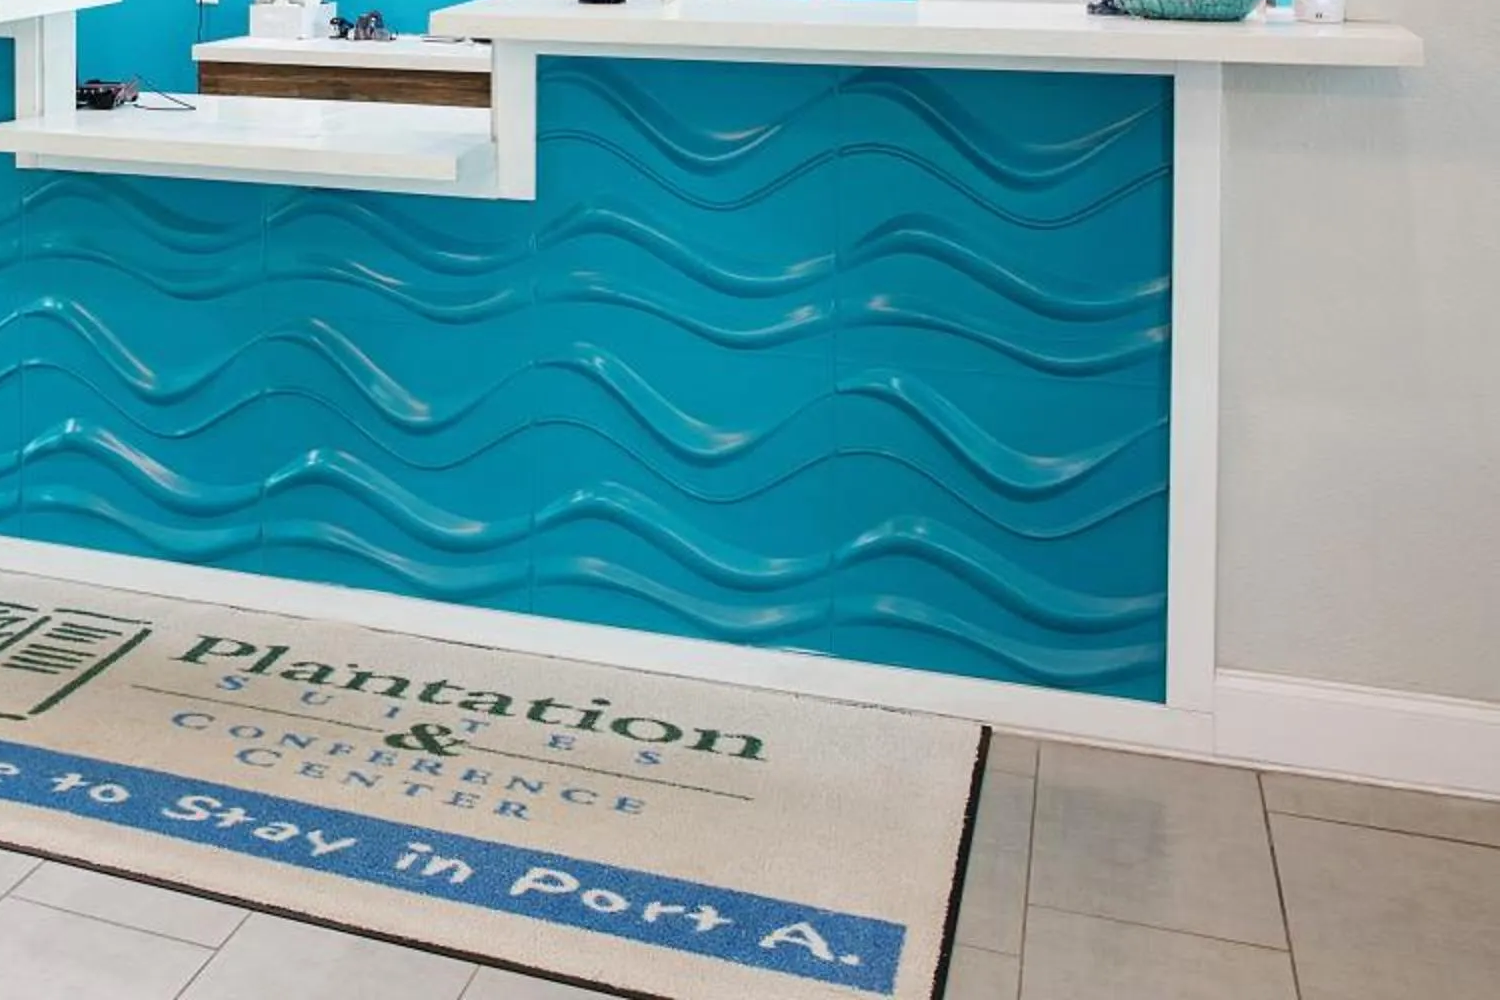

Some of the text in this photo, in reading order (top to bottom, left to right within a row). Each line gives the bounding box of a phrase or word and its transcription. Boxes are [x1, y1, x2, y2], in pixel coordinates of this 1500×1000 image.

[168, 634, 768, 762] Plantation
[217, 674, 664, 767] SUITES
[385, 723, 468, 757] &
[172, 713, 648, 815] CONFERENCE
[235, 747, 535, 821] CENTER
[50, 772, 131, 805] to
[162, 794, 357, 857] Stay
[395, 843, 475, 886] in
[509, 867, 733, 933] Port
[758, 921, 861, 967] A.
